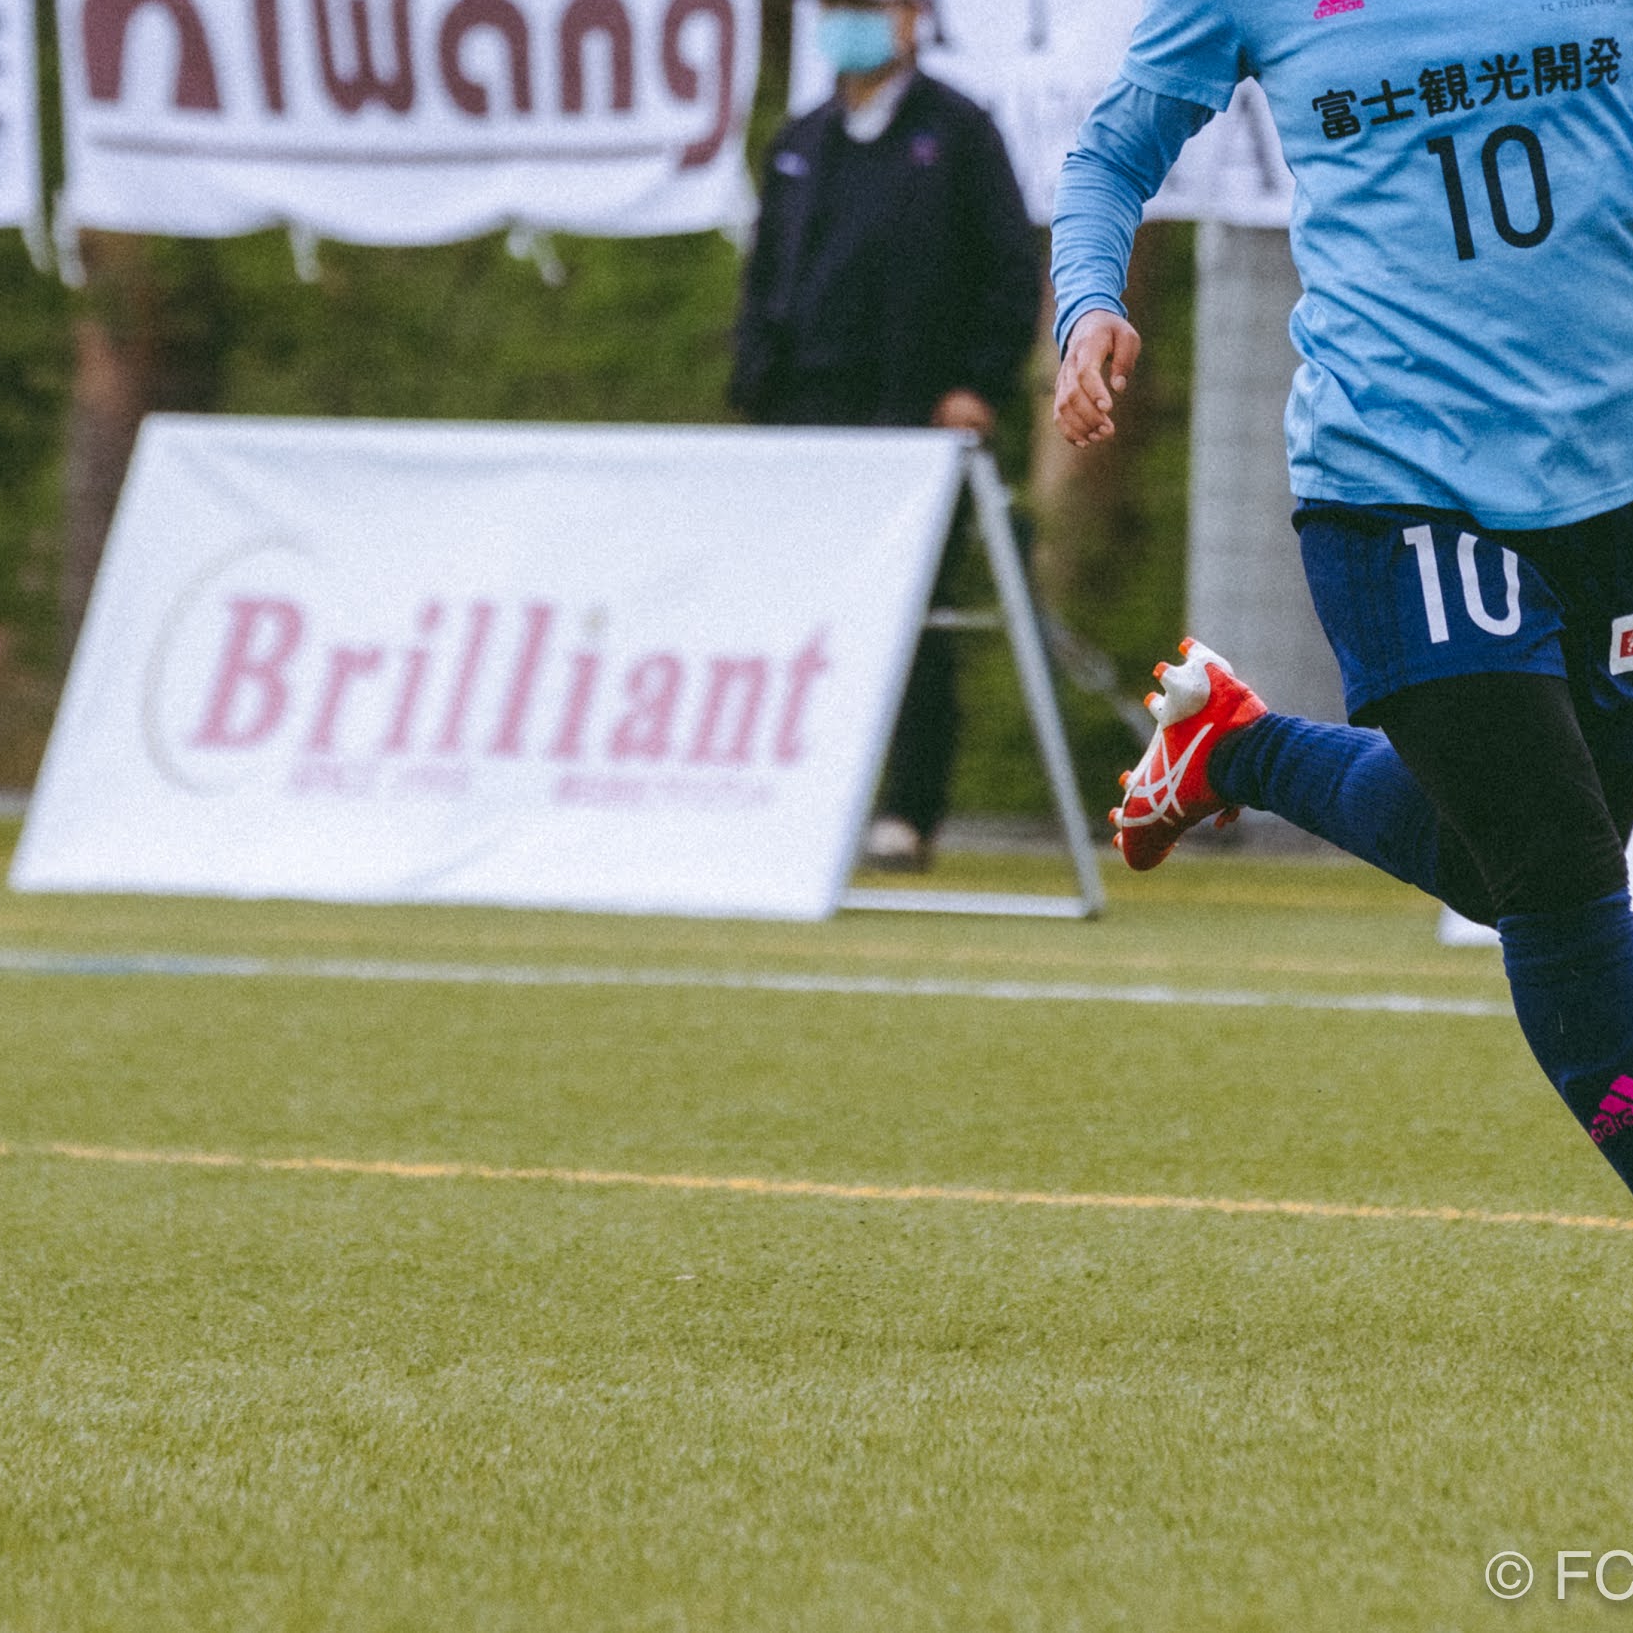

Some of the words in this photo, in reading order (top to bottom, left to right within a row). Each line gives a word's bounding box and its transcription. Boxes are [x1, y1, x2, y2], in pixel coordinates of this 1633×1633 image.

[1312, 37, 1622, 142] 富士観光開発
[1426, 123, 1555, 262] 10
[1402, 523, 1523, 644] 10
[186, 594, 834, 767] Brilliant
